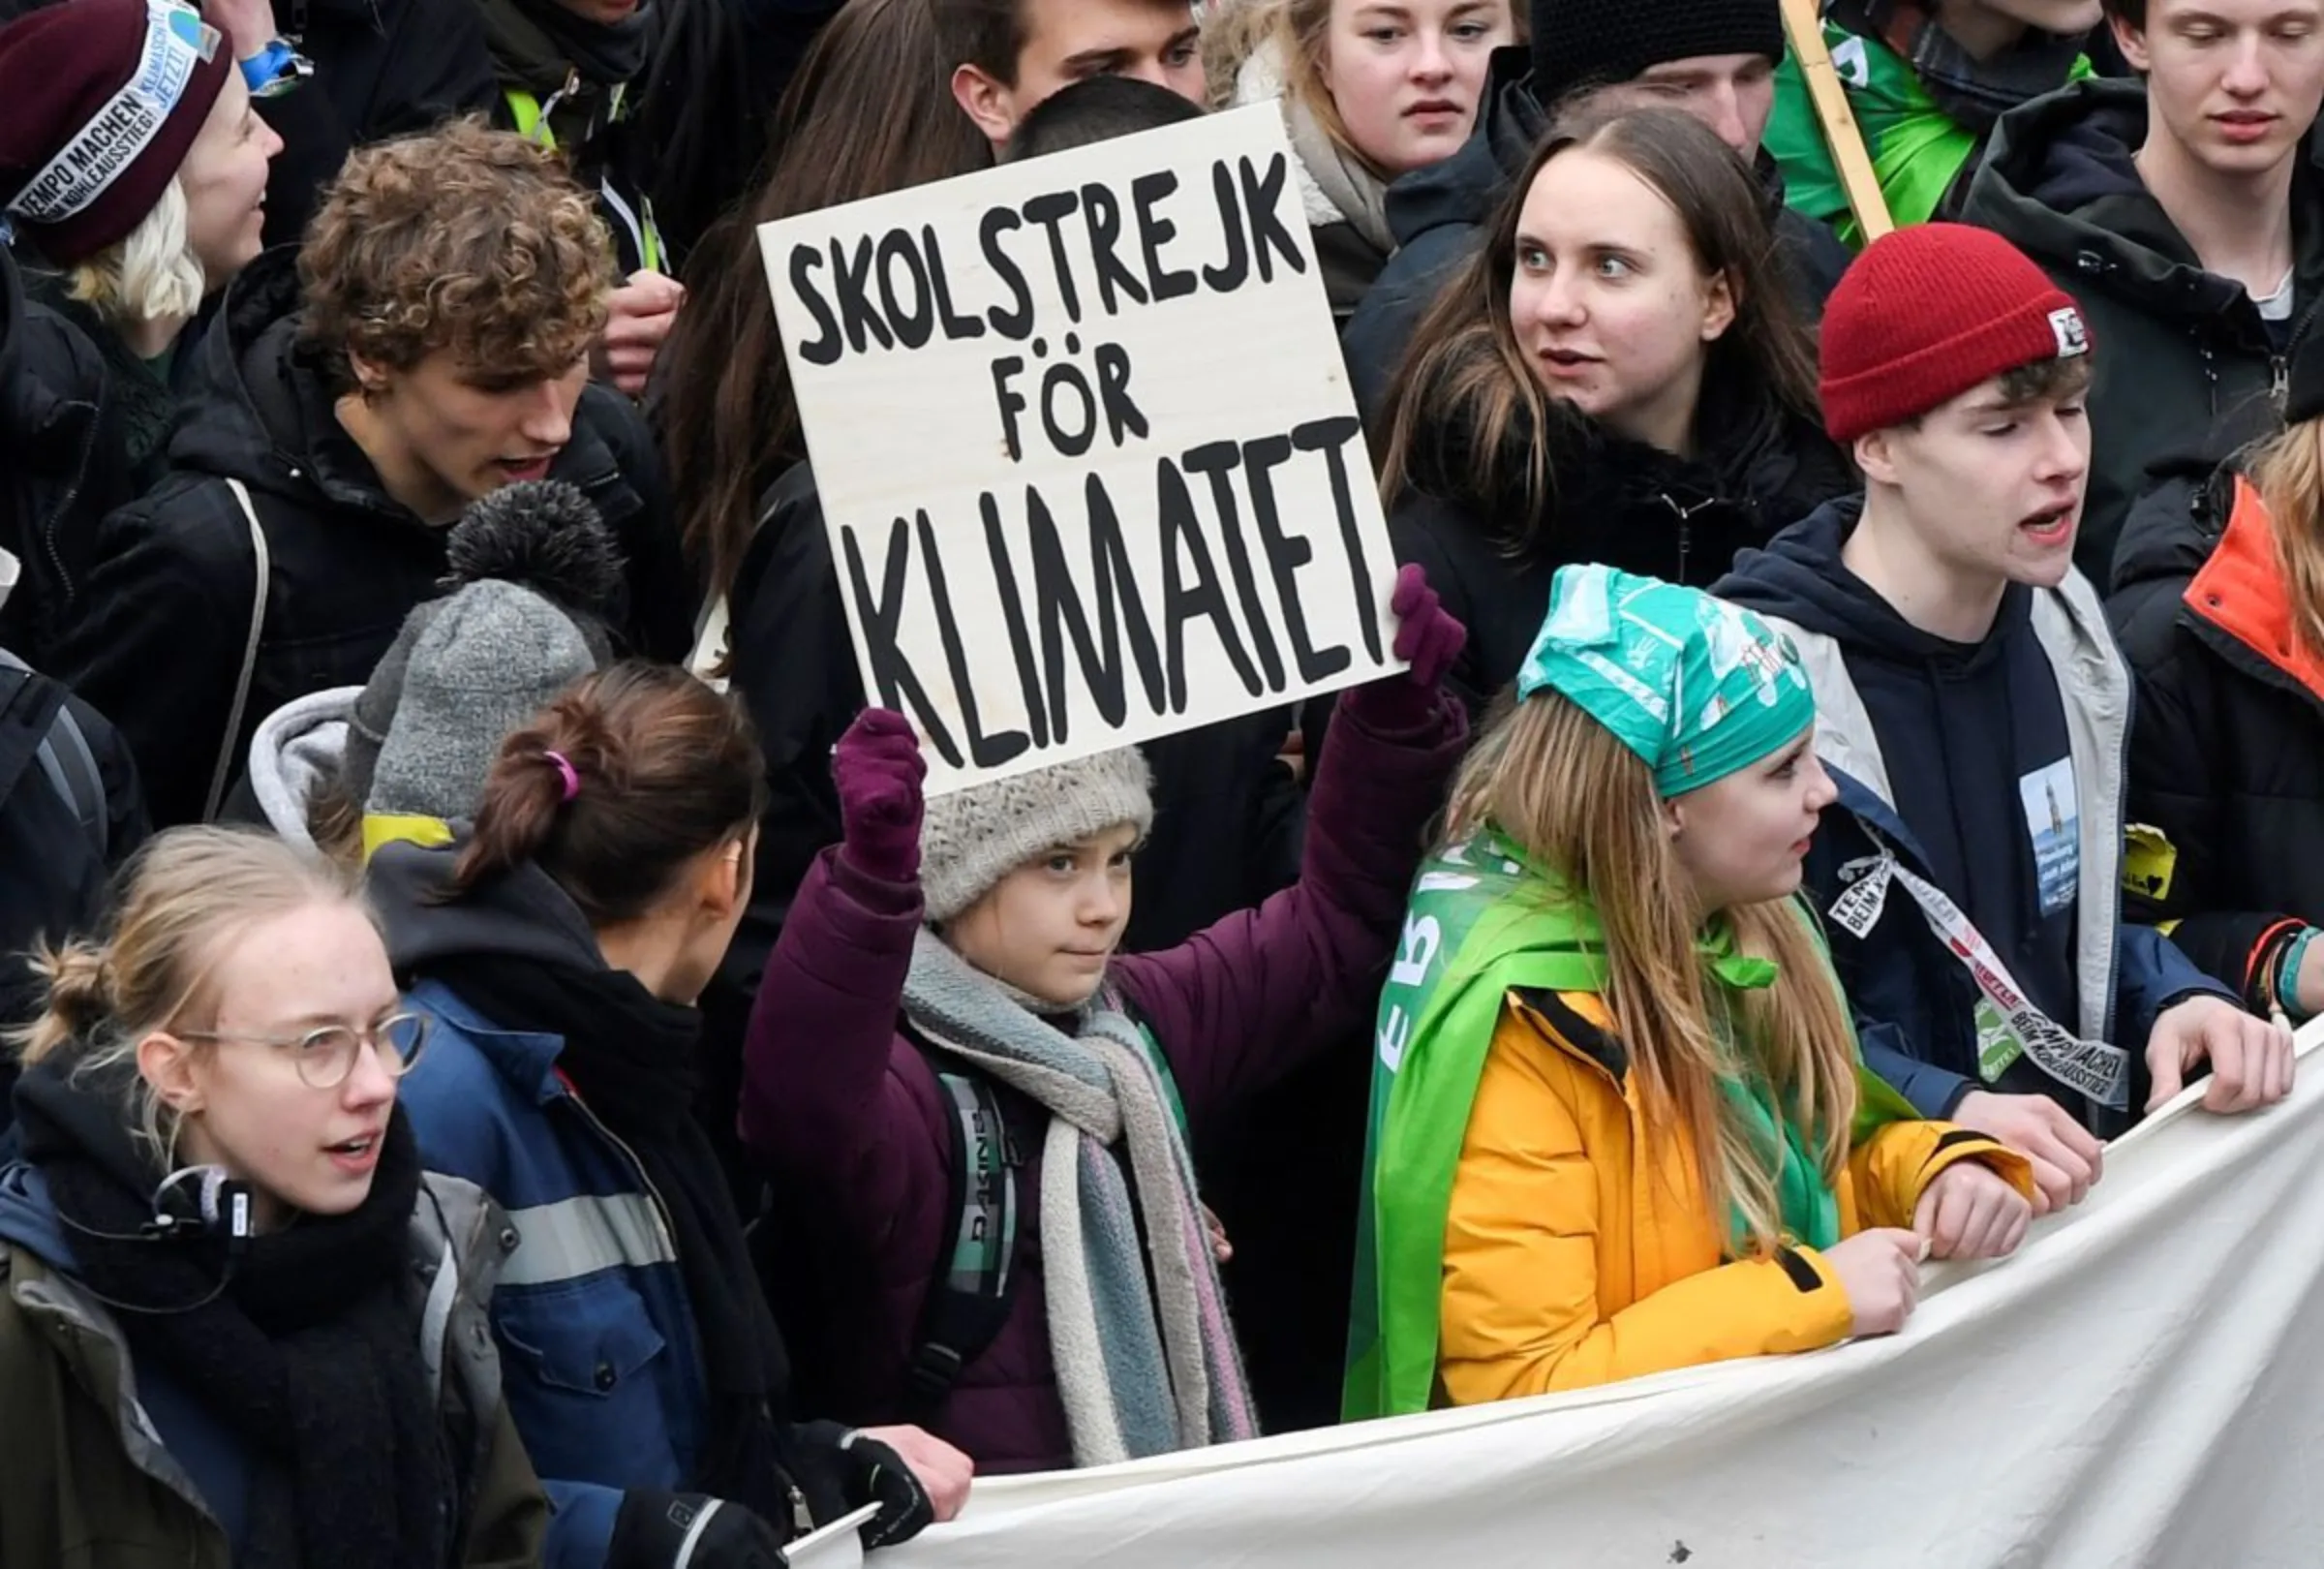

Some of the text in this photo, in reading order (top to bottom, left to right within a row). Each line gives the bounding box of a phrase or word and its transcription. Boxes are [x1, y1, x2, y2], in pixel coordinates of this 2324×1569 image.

[17, 93, 143, 215] TEMPO MACHEN
[61, 109, 158, 208] KOHLEAUSSTIEG!
[790, 153, 1306, 366] SKOLSTREJK
[992, 332, 1149, 463] FÖR
[841, 416, 1384, 770] KLIMATET
[1847, 891, 1881, 931] BEIM
